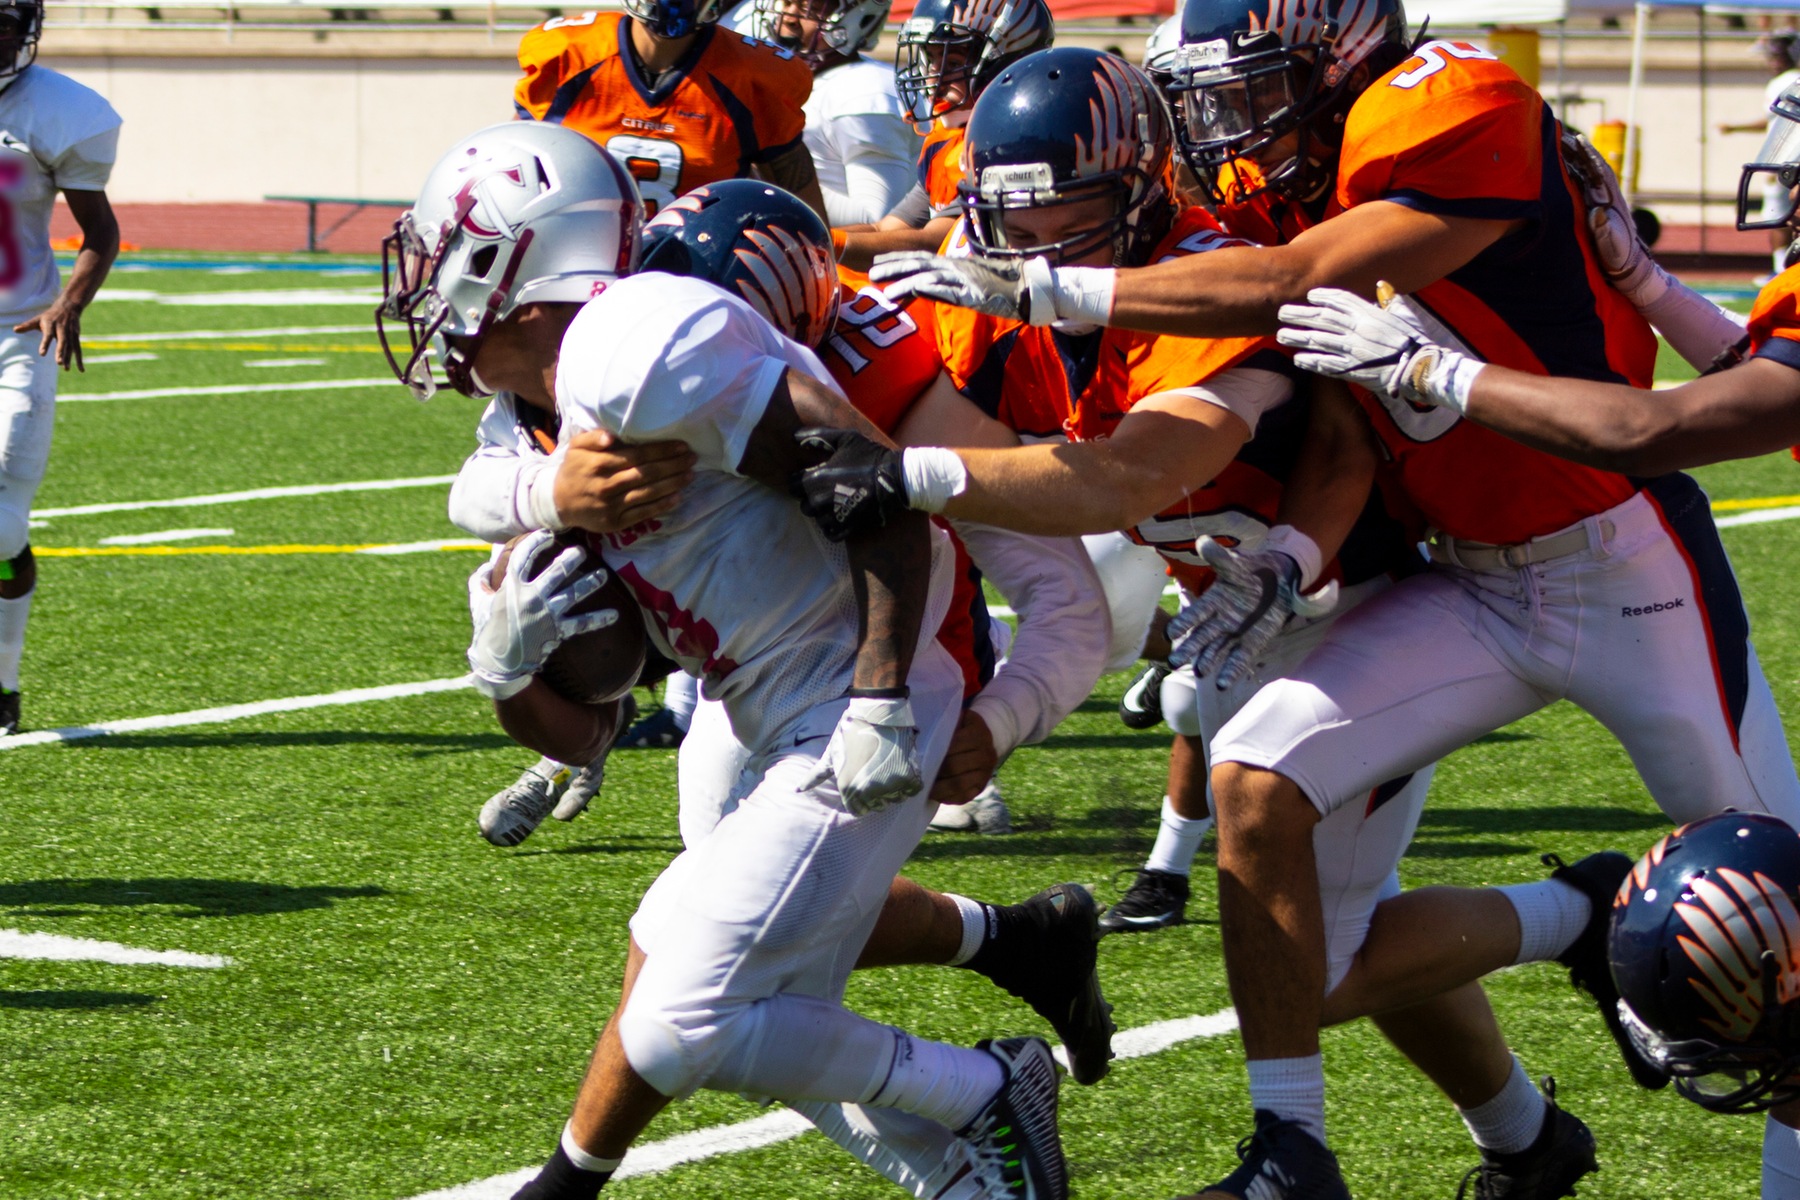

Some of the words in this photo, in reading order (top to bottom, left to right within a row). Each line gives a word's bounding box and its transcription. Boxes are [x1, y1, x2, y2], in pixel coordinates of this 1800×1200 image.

[621, 118, 675, 133] CITRUS
[1004, 171, 1032, 182] schutt
[836, 487, 868, 522] adidas
[1621, 598, 1684, 617] Reebok
